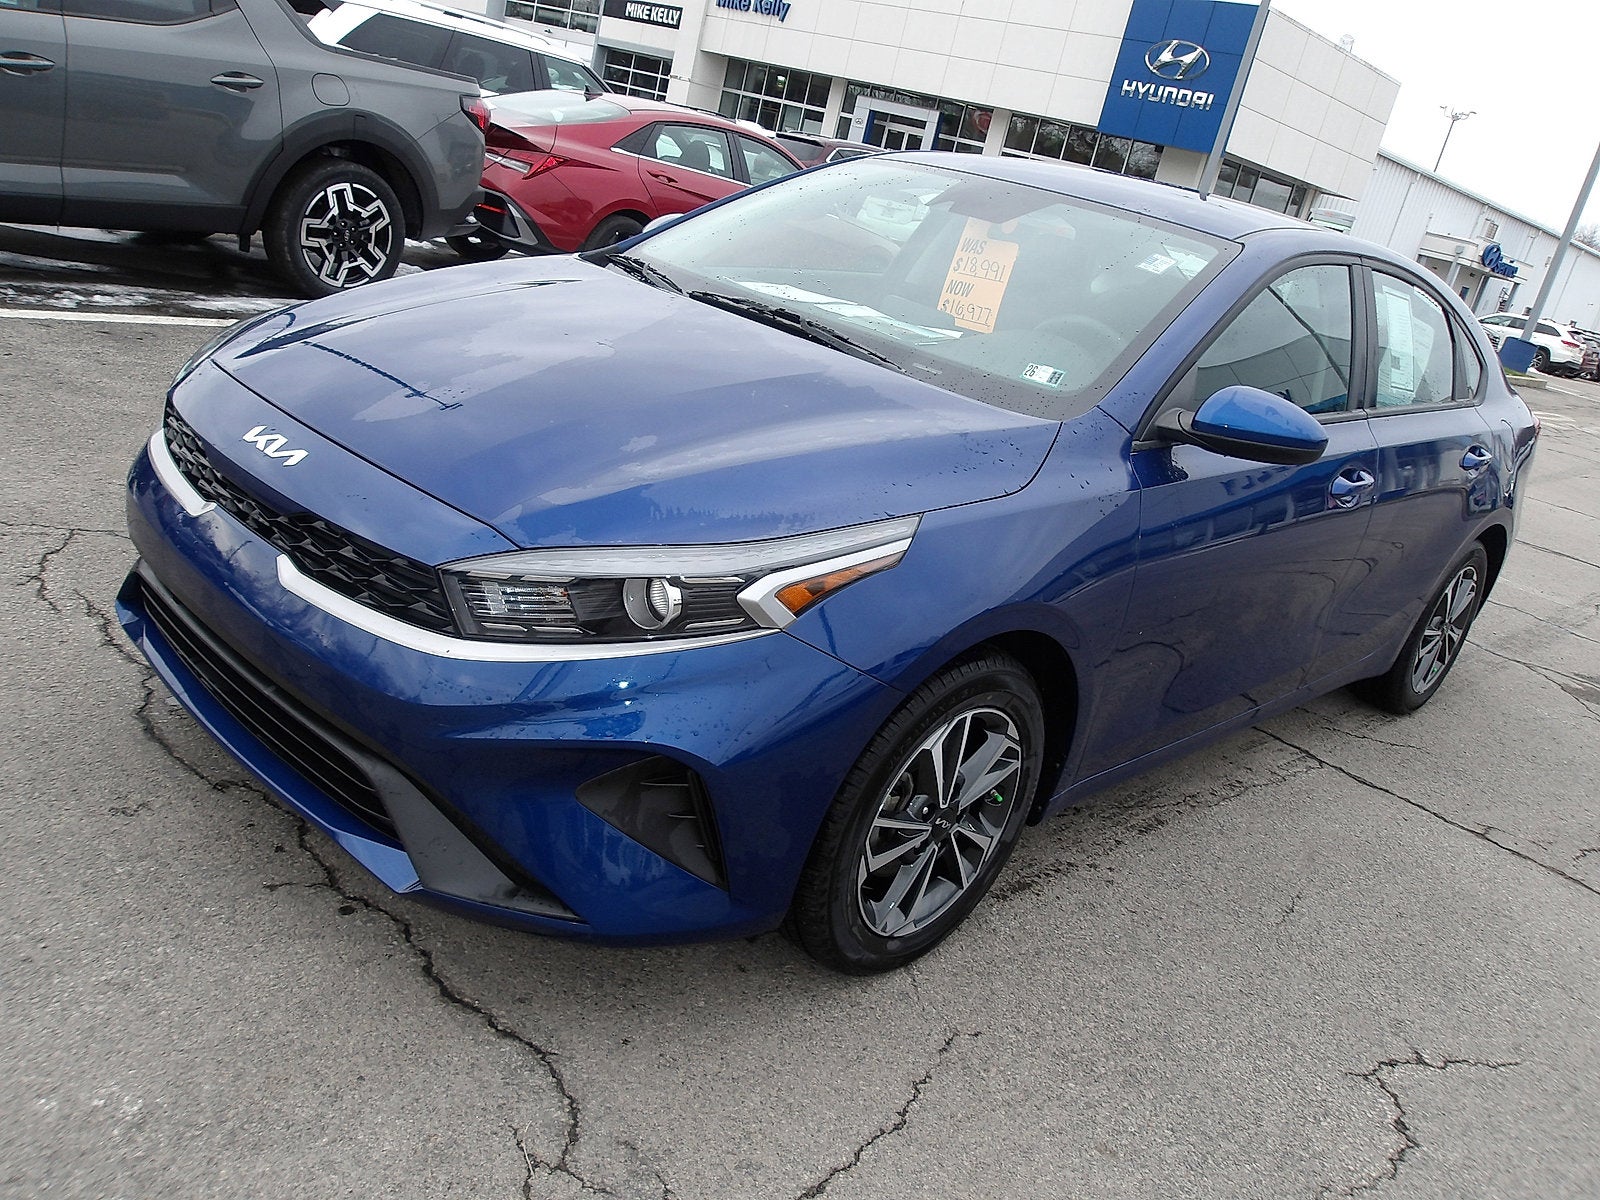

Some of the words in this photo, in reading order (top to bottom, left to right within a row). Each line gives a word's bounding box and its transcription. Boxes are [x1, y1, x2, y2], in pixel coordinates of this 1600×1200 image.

[625, 2, 650, 20] MIKE
[650, 6, 680, 25] KELLY
[752, 0, 791, 22] Kelly
[1120, 79, 1215, 111] HYUNDAI
[960, 237, 987, 255] WAS
[945, 279, 975, 298] NOW
[1024, 364, 1039, 378] 26
[242, 425, 309, 467] KIA
